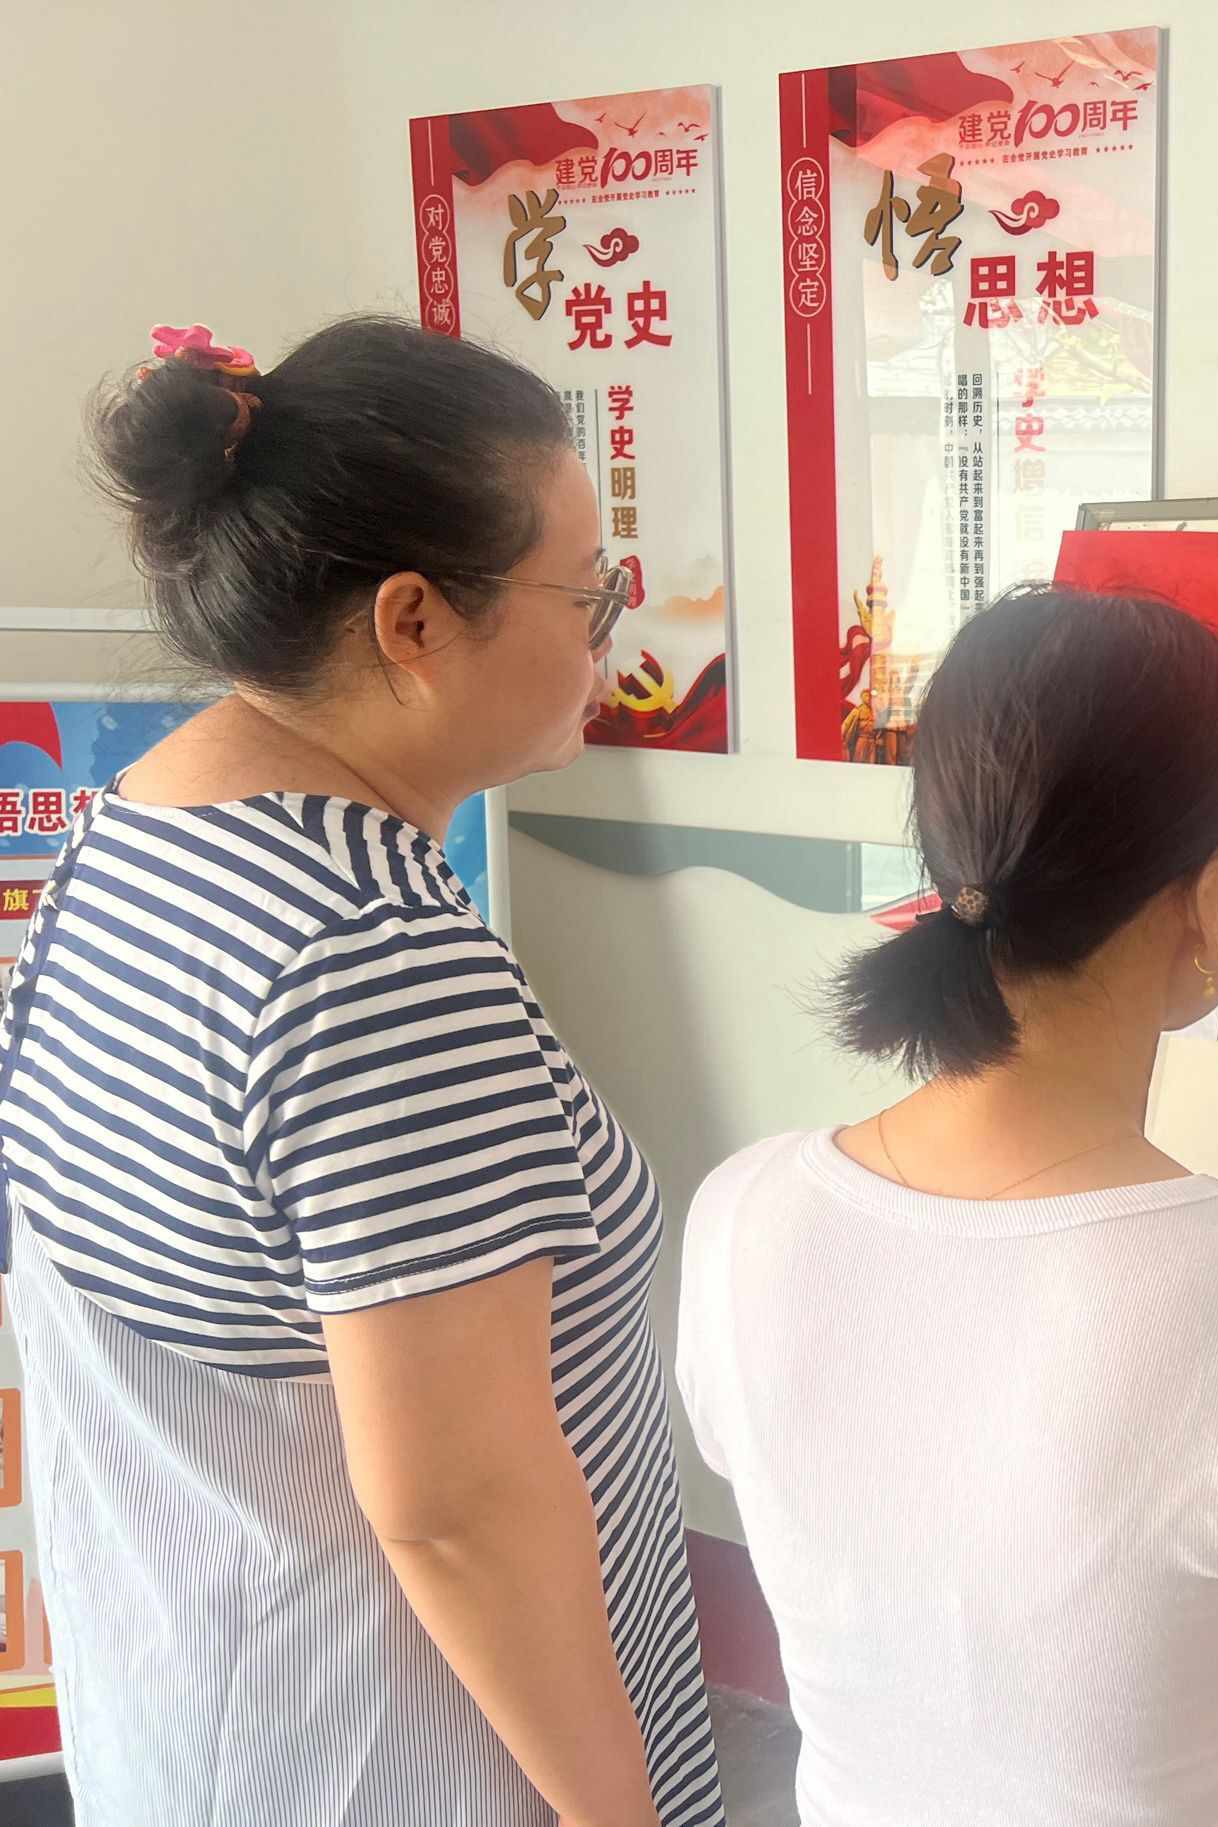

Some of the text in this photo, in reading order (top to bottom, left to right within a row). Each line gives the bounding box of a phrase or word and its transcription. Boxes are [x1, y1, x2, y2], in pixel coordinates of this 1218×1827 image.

[555, 147, 698, 188] 建党100周年
[958, 100, 1138, 149] 建党100周年
[425, 203, 452, 326] 对党忠诚
[503, 188, 567, 320] 学
[794, 169, 822, 310] 信念坚定
[864, 153, 964, 281] 悟
[565, 280, 673, 350] 党史
[963, 251, 1099, 329] 思想
[608, 385, 639, 539] 学史明理
